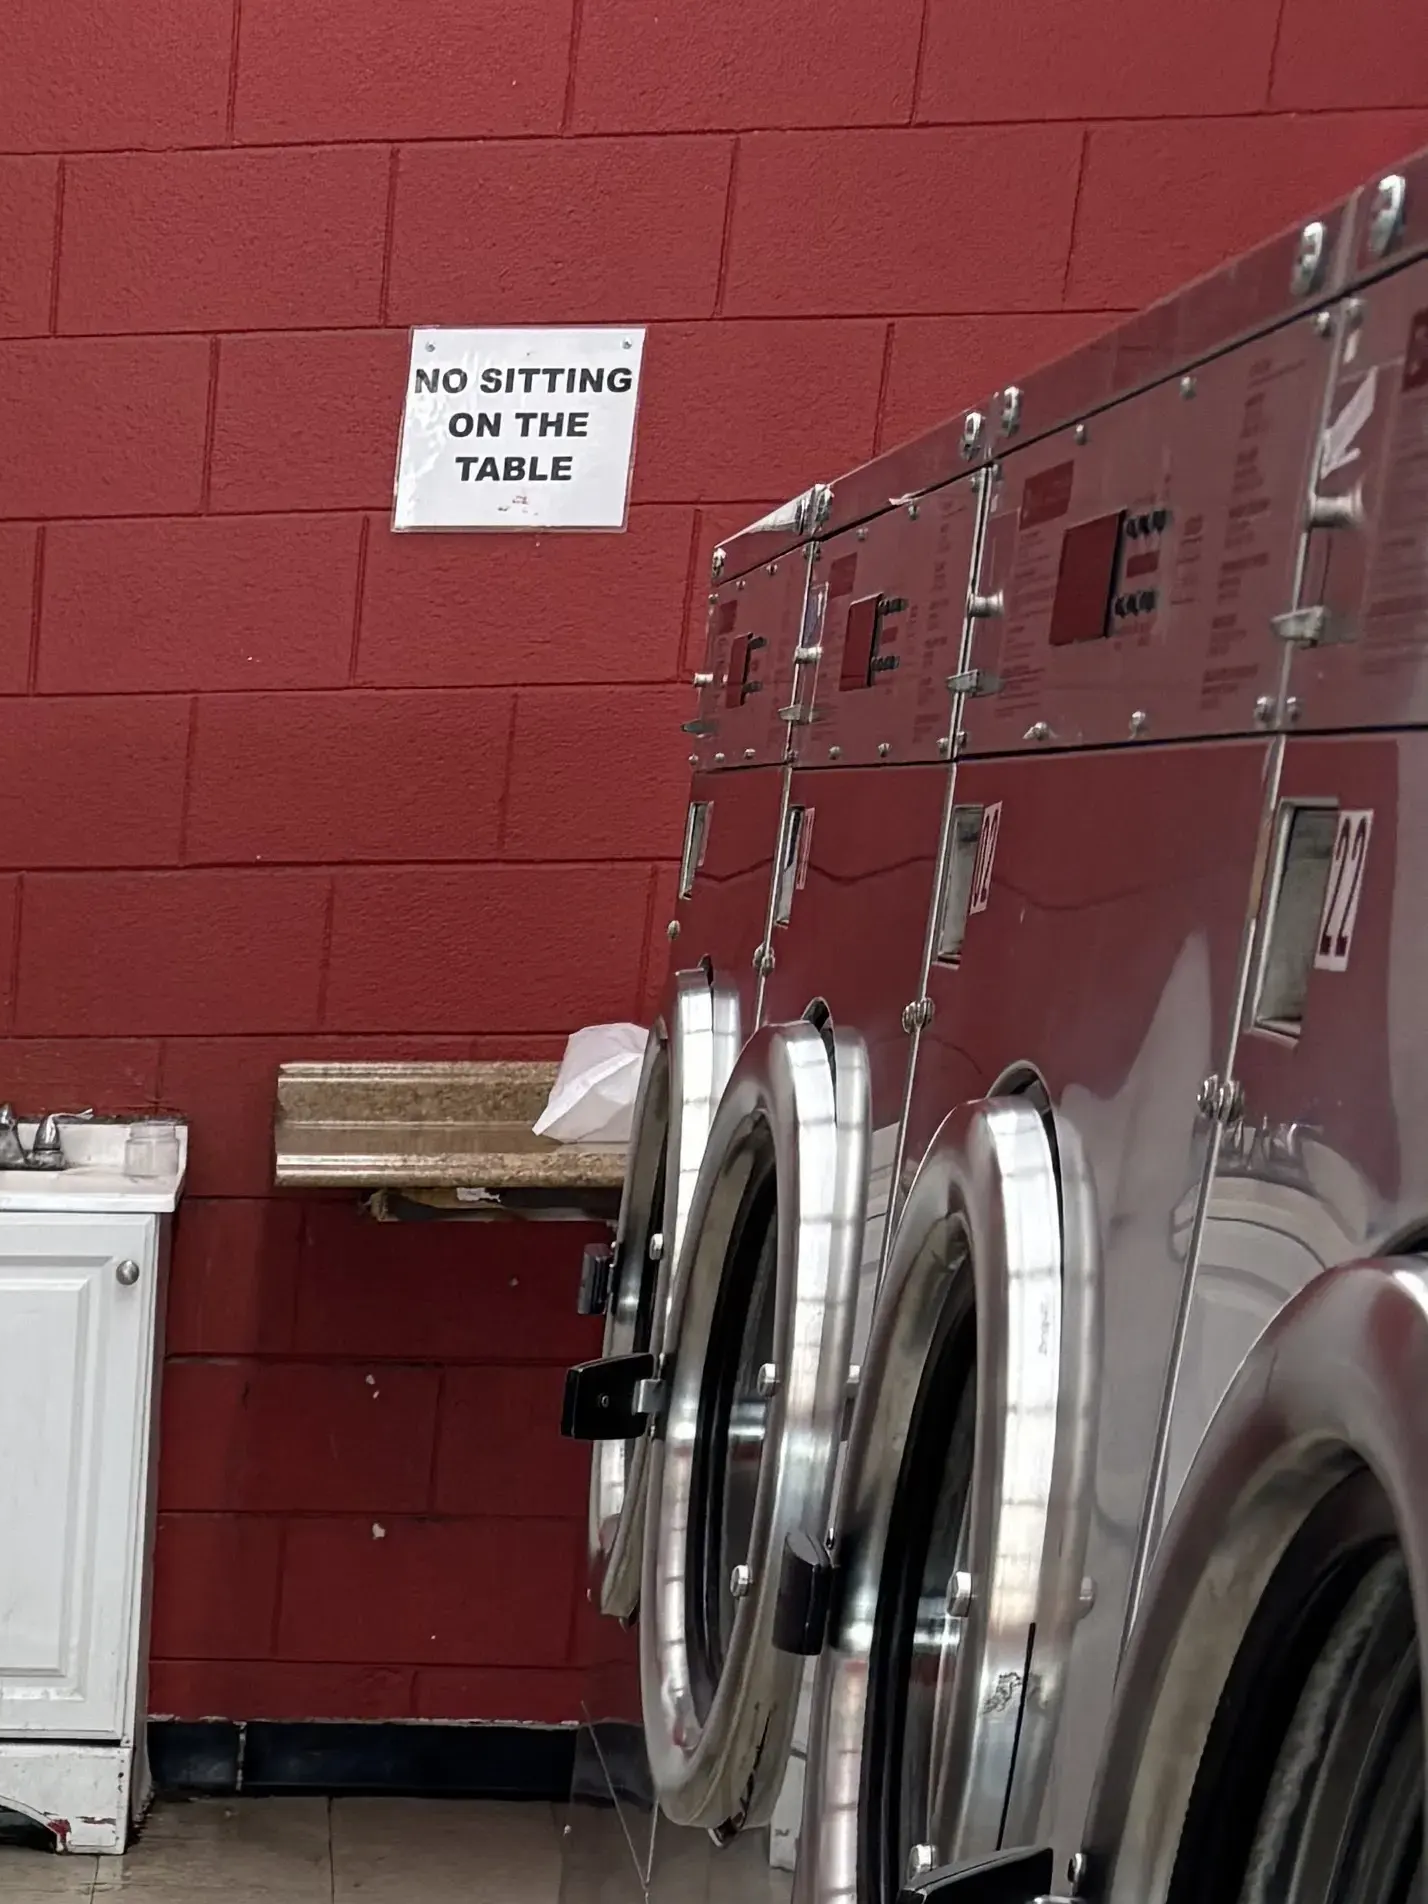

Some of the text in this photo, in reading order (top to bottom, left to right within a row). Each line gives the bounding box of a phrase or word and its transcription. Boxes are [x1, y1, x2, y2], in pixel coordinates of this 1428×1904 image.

[414, 367, 633, 394] NO SITTING
[448, 412, 589, 437] ON THE
[455, 456, 573, 481] TABLE
[1319, 816, 1368, 957] 22
